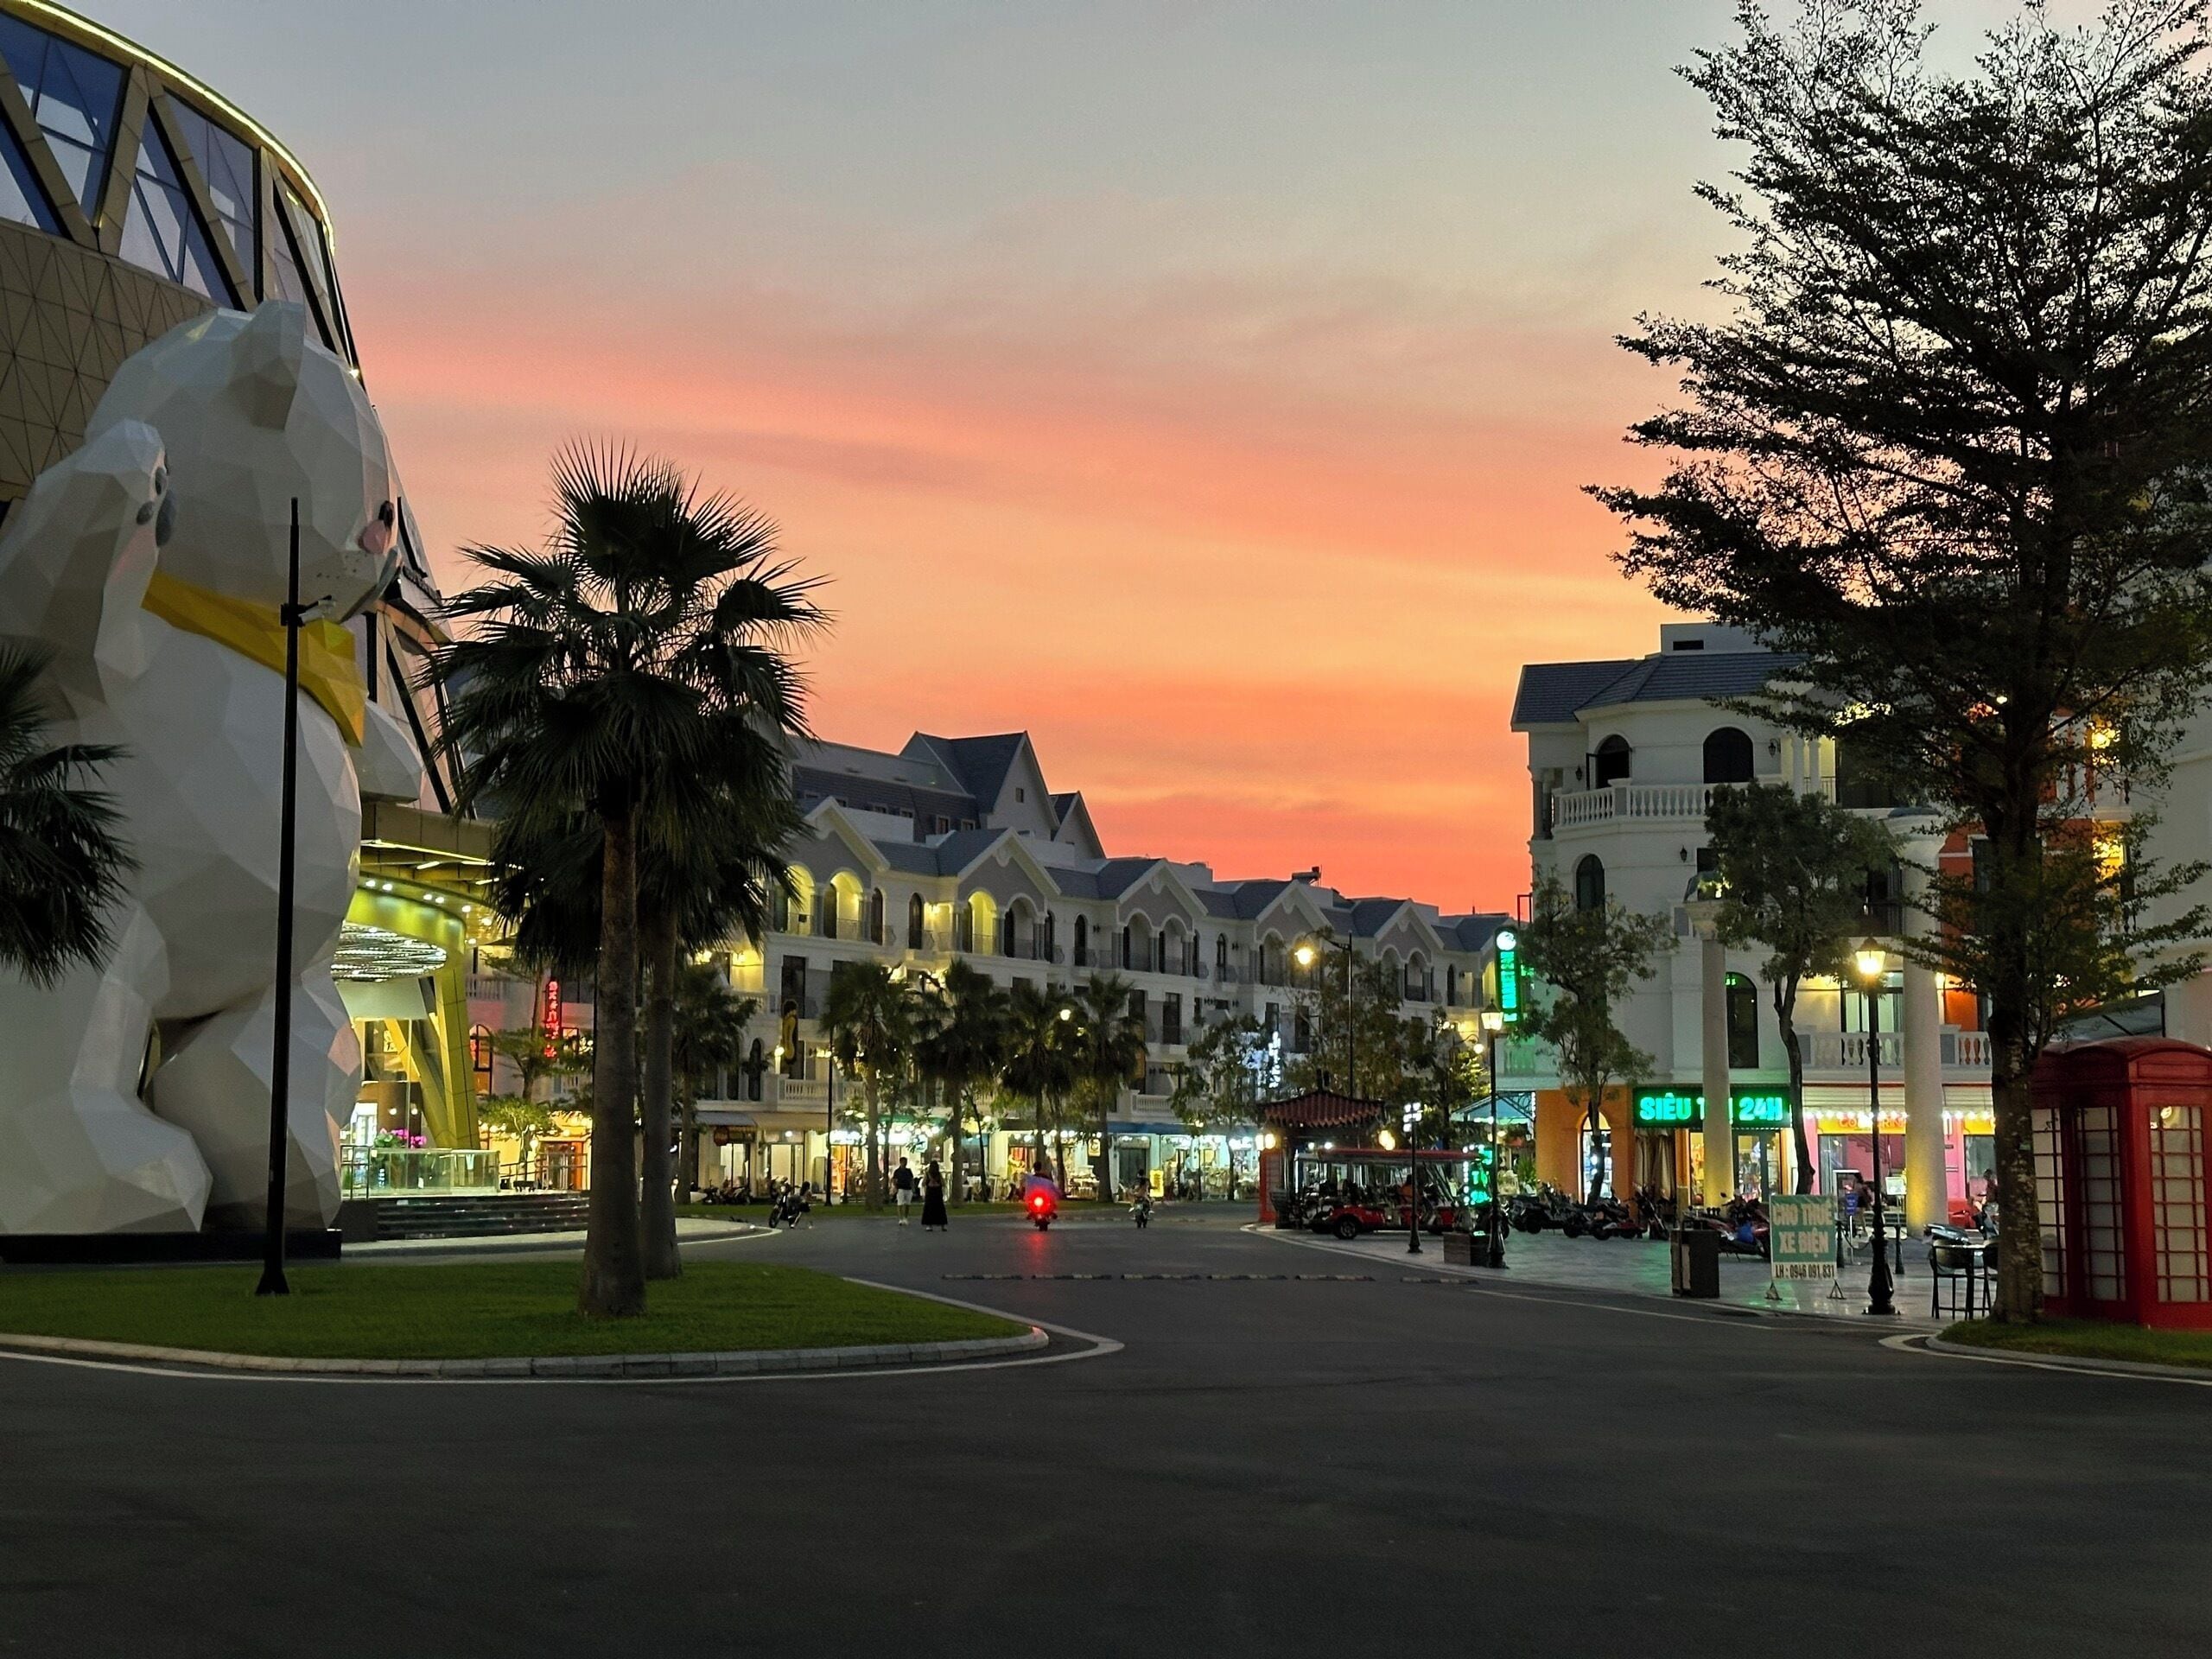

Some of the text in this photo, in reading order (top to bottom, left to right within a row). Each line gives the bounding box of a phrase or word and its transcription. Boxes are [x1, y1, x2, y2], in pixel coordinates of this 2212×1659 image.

[1640, 1092, 1691, 1121] SIÊU
[1738, 1096, 1783, 1122] 24H
[1773, 1204, 1798, 1225] CHO
[1779, 1230, 1796, 1254] XE
